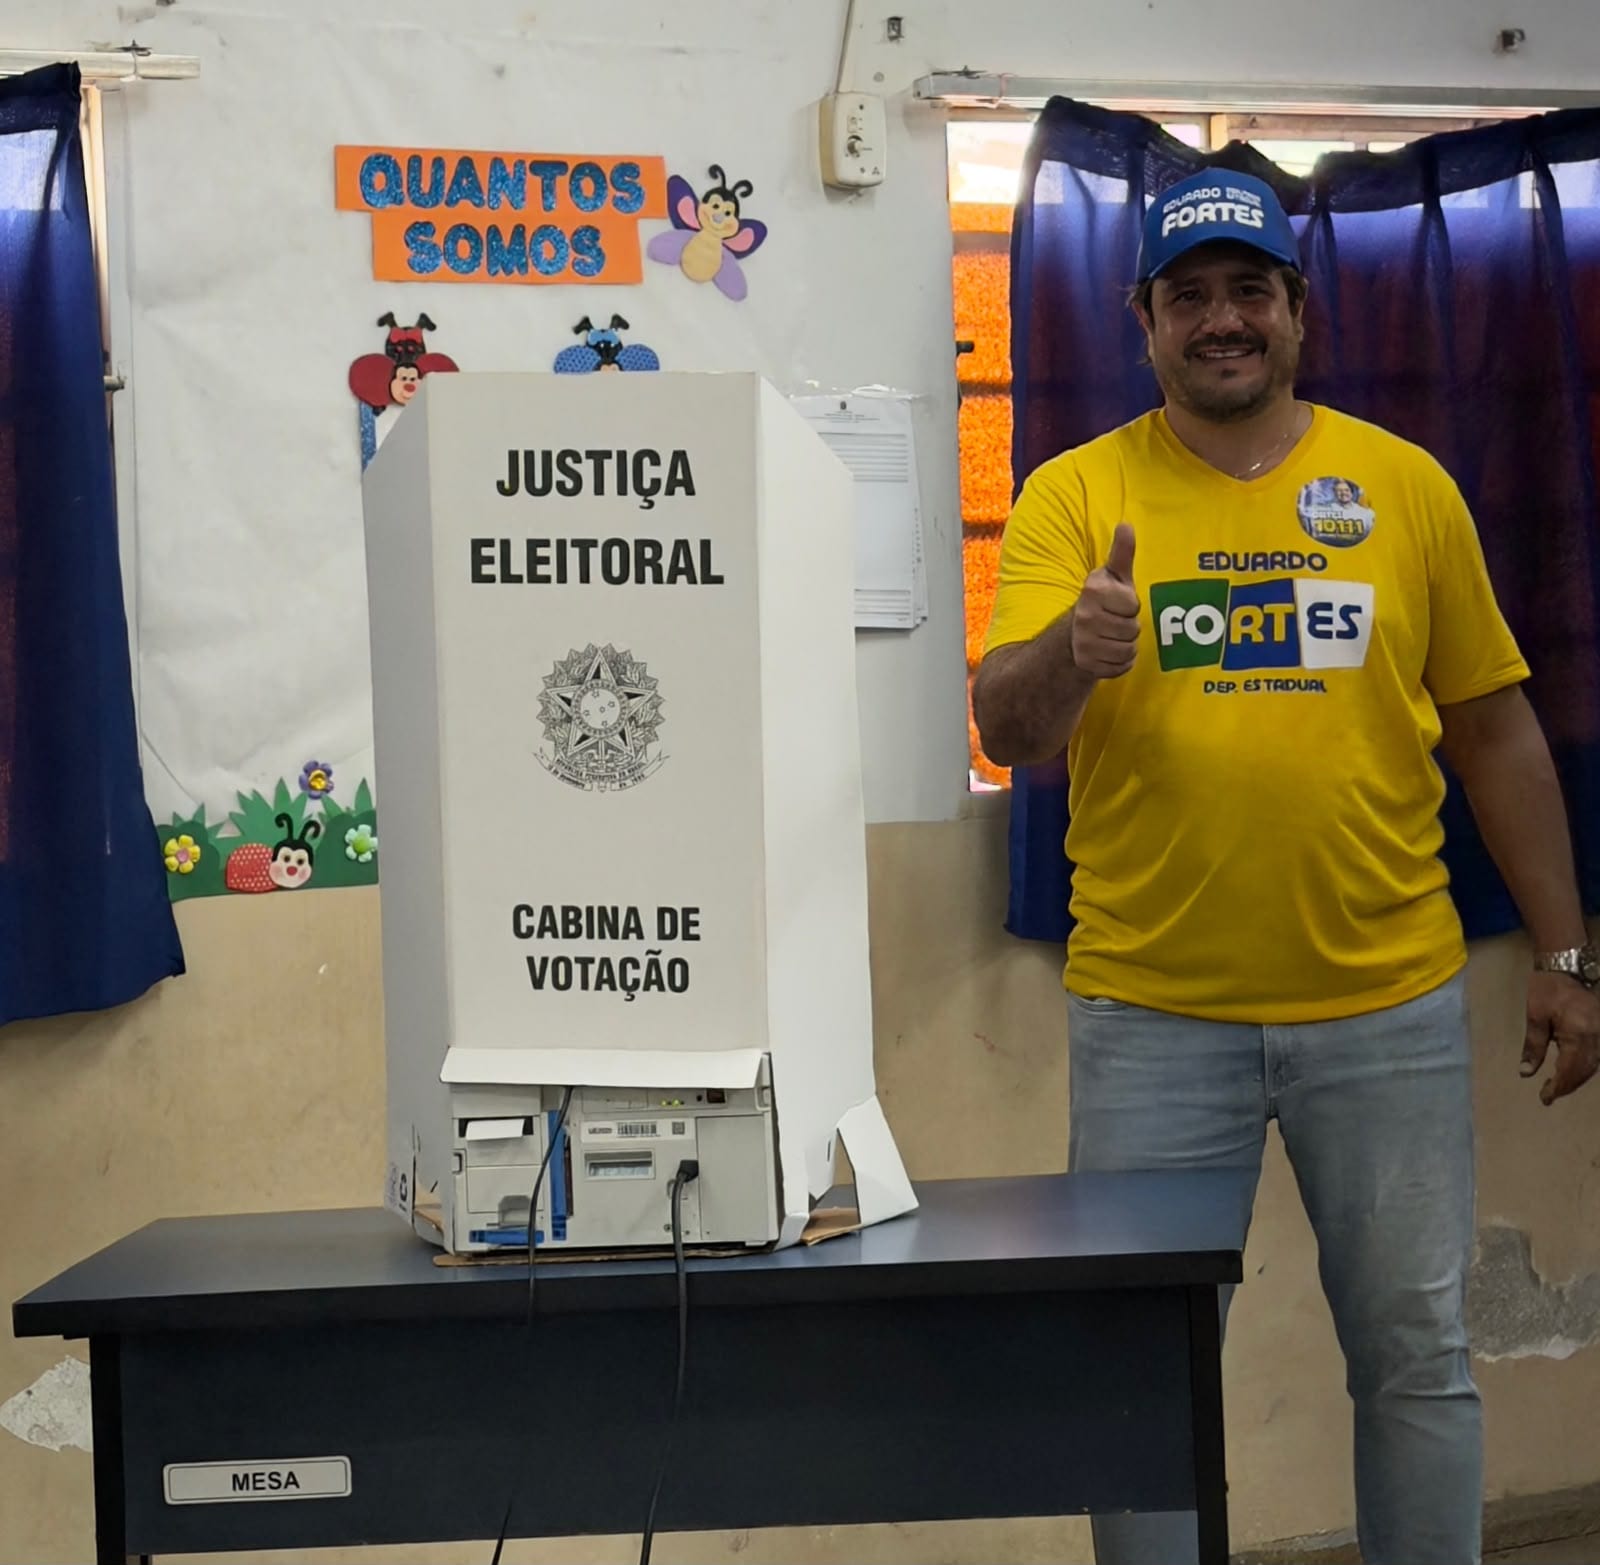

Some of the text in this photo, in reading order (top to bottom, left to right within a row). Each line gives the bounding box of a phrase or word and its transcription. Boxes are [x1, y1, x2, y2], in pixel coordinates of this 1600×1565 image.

[359, 153, 645, 214] QUANTOS
[1162, 202, 1264, 237] FORTES
[404, 221, 606, 277] SOMOS
[496, 449, 696, 510] JUSTIÇA
[1313, 518, 1364, 535] 10111
[471, 538, 724, 585] ELEITORAL
[1198, 551, 1328, 572] EDUARDO
[1159, 601, 1363, 647] FORTES
[1203, 678, 1327, 694] DEP. ESTADUAL
[512, 904, 701, 941] CABINA DE
[526, 949, 690, 1002] VOTAÇÃO
[232, 1471, 300, 1492] MESA
